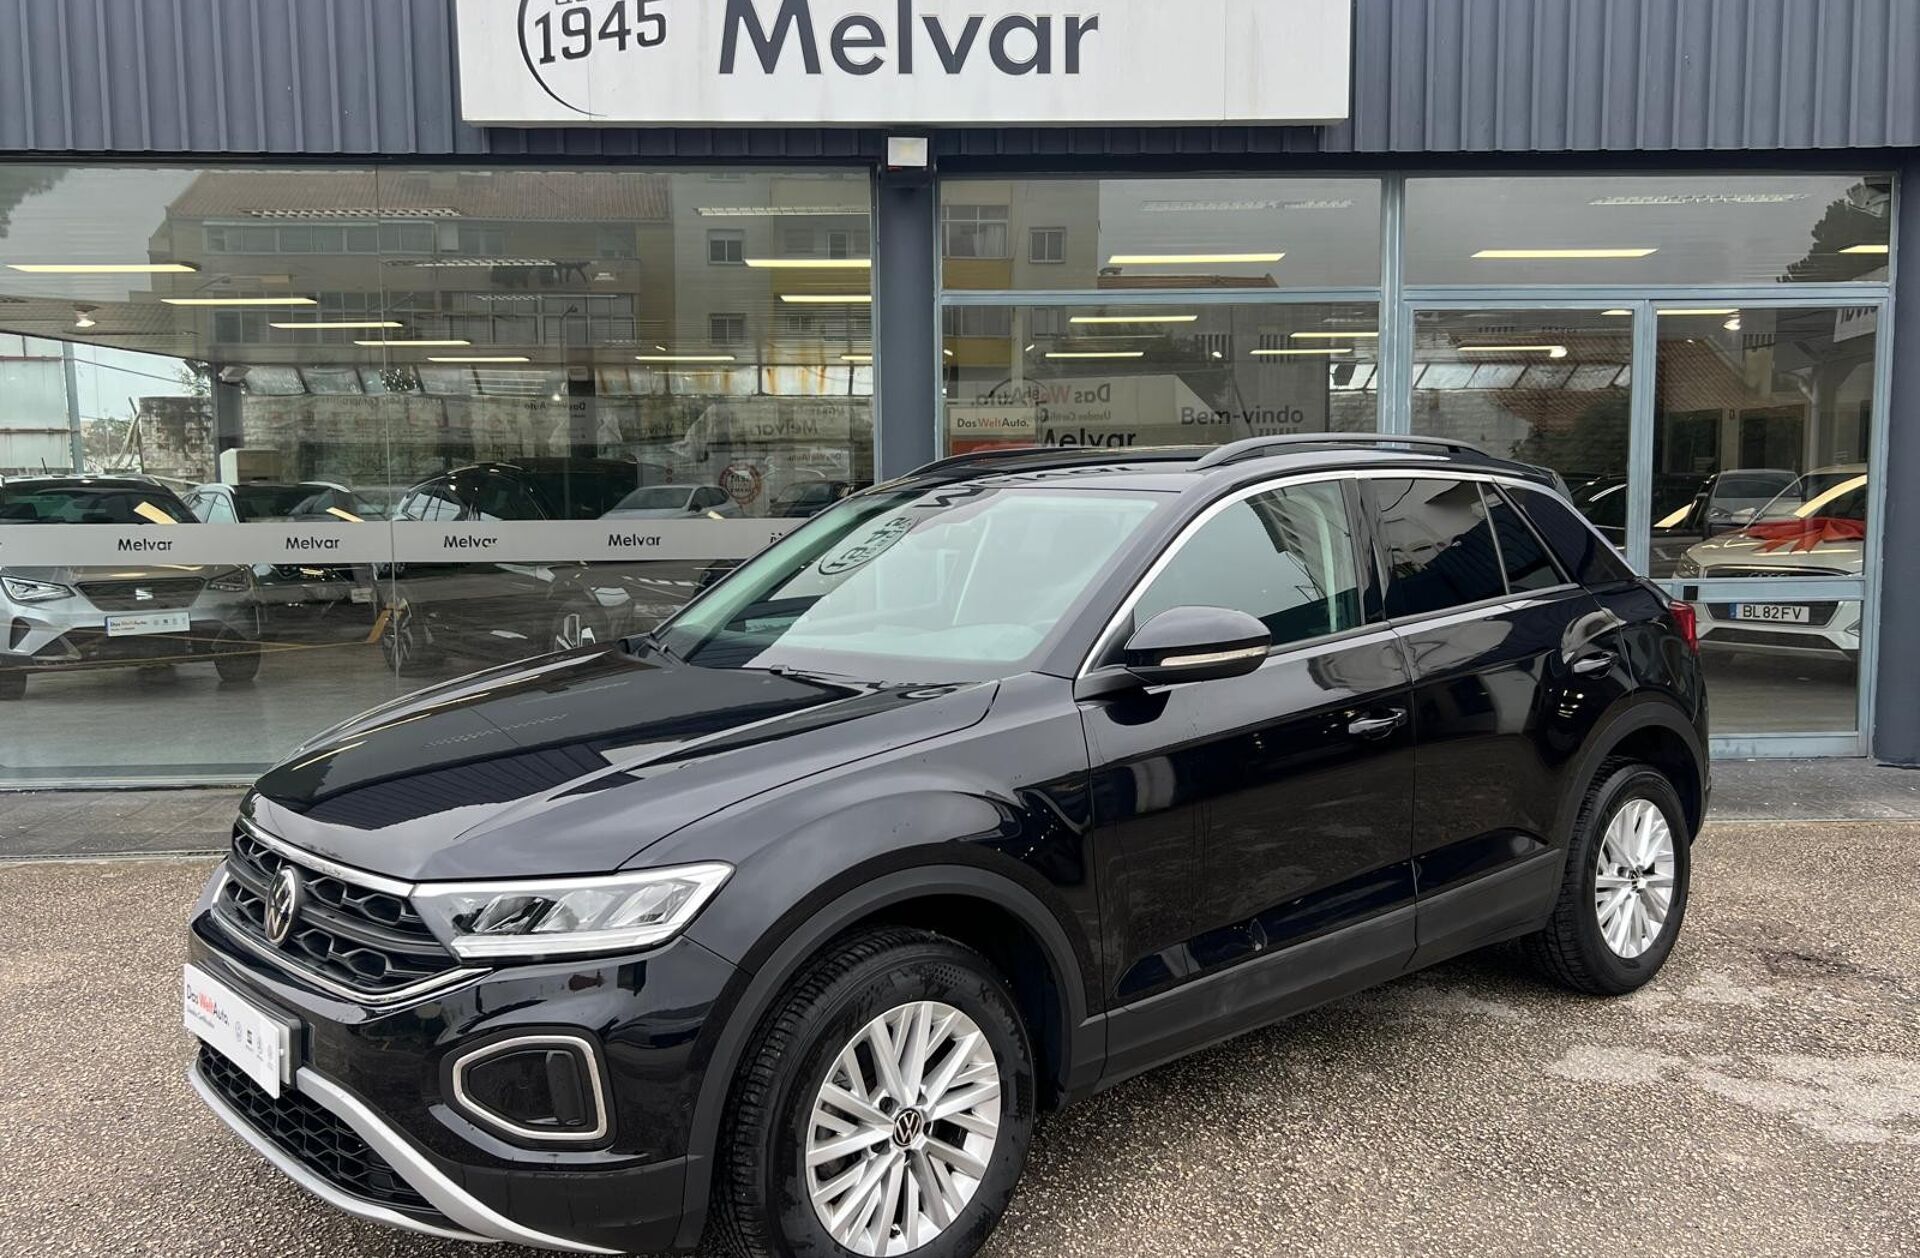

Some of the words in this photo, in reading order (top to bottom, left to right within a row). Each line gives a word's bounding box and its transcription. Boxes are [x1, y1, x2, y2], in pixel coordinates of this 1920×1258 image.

[535, 0, 667, 65] 1945
[719, 0, 1100, 76] Melvar
[1180, 405, 1304, 425] Bem-vindo
[117, 538, 173, 552] Melvar
[285, 536, 340, 550] Melvar
[443, 535, 498, 549] Melvar
[608, 534, 661, 547] Melvar
